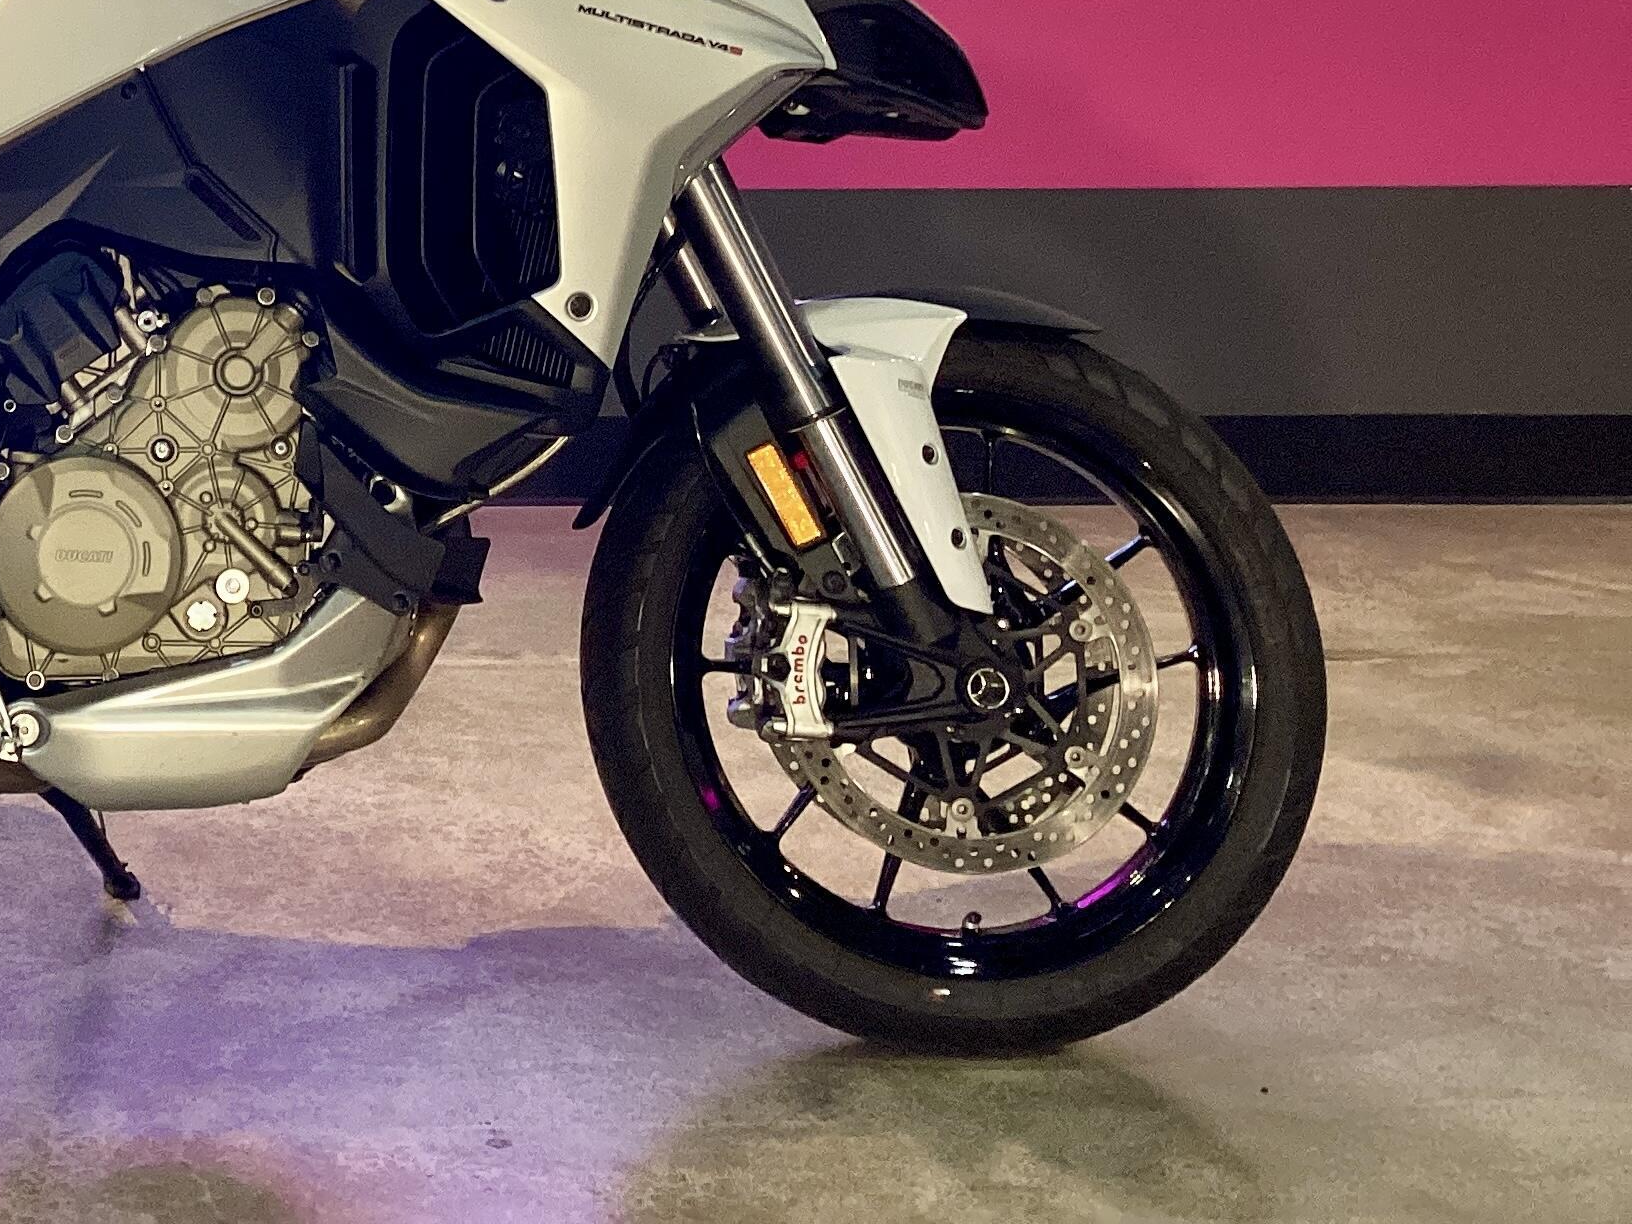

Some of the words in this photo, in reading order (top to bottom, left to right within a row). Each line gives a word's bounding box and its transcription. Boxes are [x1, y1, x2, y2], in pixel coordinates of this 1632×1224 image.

[578, 4, 706, 45] MULTISTRADA
[54, 549, 114, 563] DUCATI
[791, 634, 808, 705] brembo
